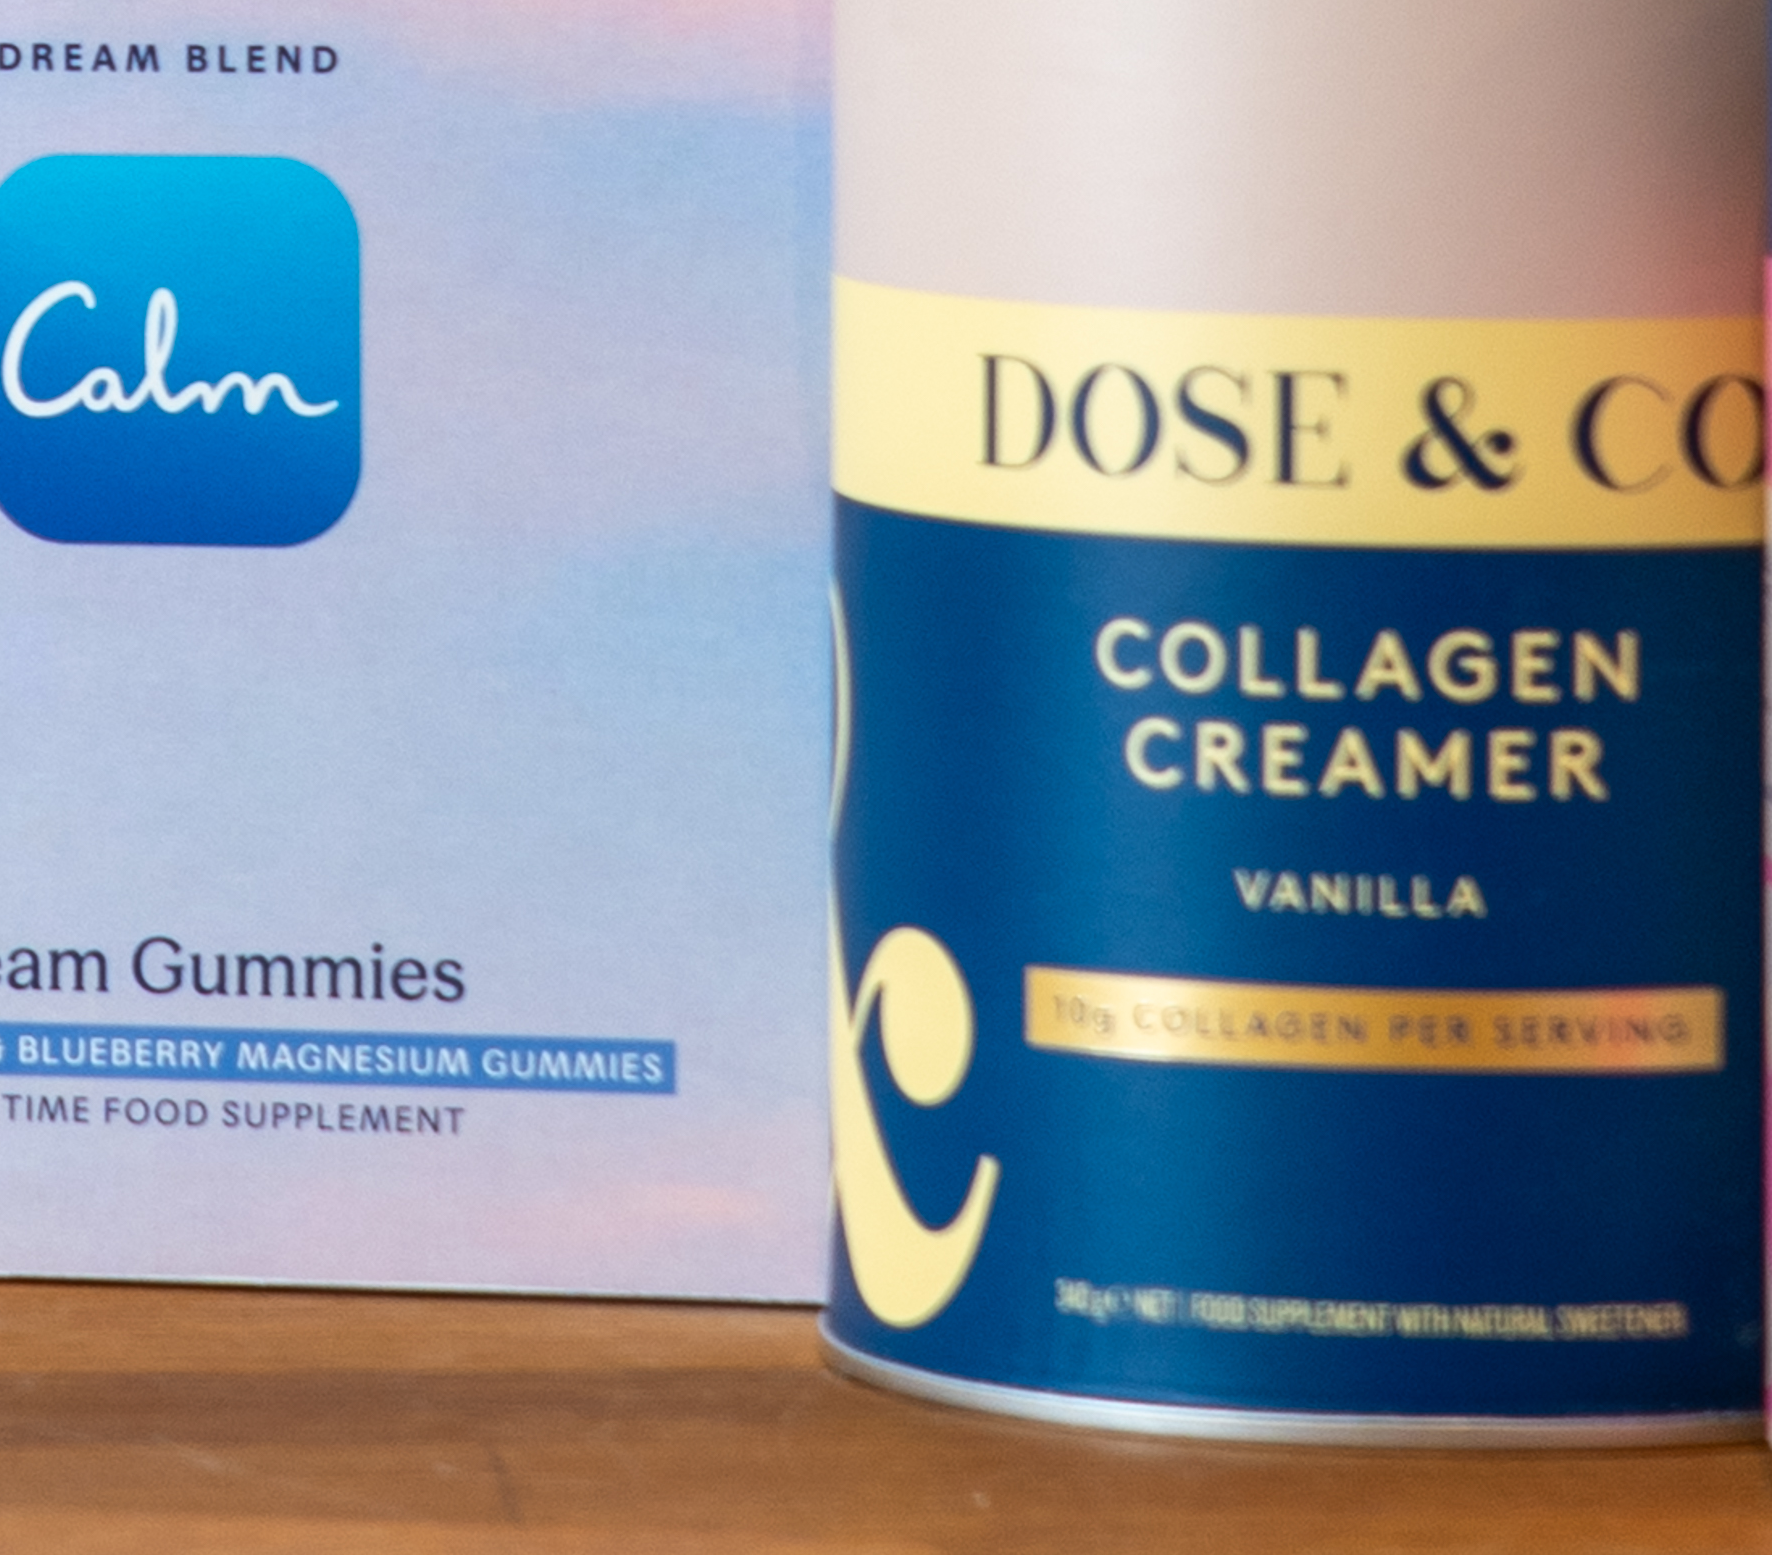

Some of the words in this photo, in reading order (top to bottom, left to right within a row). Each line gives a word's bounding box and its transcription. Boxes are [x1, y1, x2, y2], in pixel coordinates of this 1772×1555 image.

[185, 43, 341, 76] BLEND
[2, 280, 339, 418] Calm
[977, 353, 1351, 488] DOSE
[1400, 377, 1523, 494] &
[1094, 616, 1643, 703] COLLAGEN
[1123, 716, 1611, 802] CREAMER
[1233, 869, 1488, 919] VANILLA
[131, 935, 467, 1004] Gummies
[17, 1034, 225, 1071] BLUEBERRY
[235, 1040, 472, 1077] MAGNESIUM
[482, 1048, 664, 1083] GUMMIES
[1493, 1012, 1691, 1048] SERVING
[103, 1096, 209, 1128] FOOD
[220, 1100, 464, 1135] SUPPLEMENT
